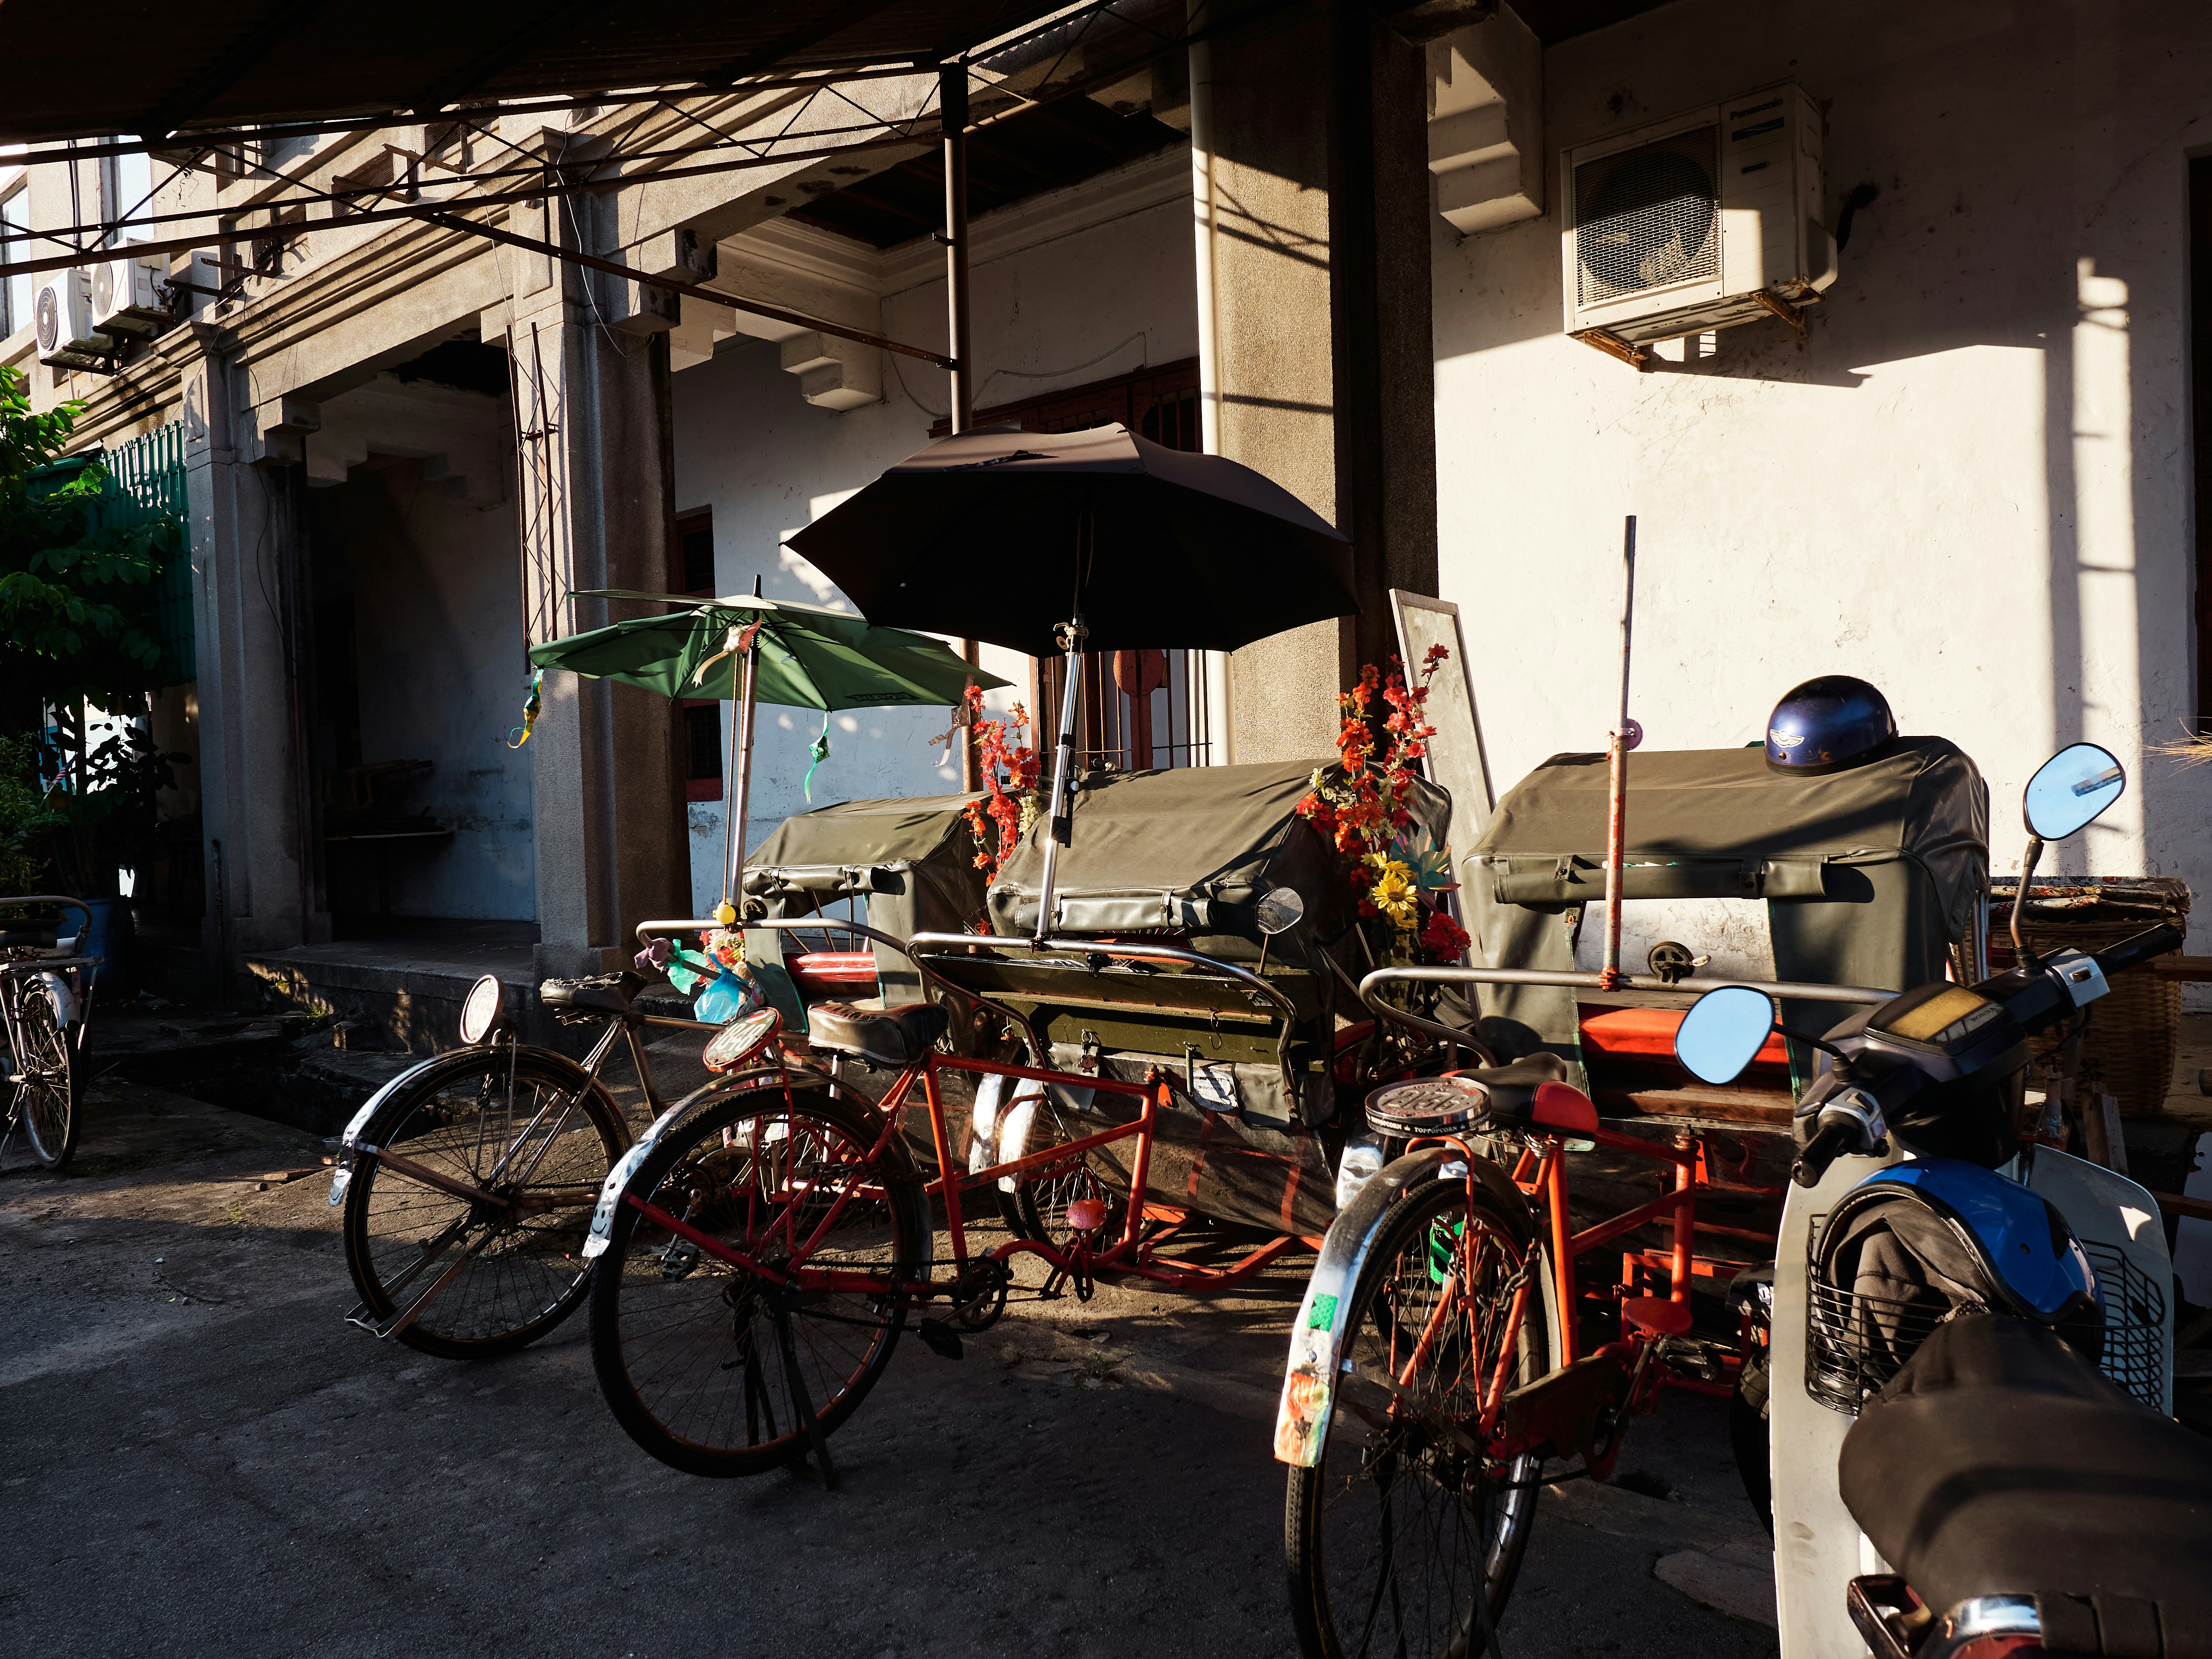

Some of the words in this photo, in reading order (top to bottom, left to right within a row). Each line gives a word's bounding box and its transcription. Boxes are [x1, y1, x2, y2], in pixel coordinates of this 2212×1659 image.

[1730, 98, 1783, 120] Panasonic
[1970, 1007, 1997, 1022] HONDA
[1414, 1124, 1458, 1134] TOPPOPCORN
